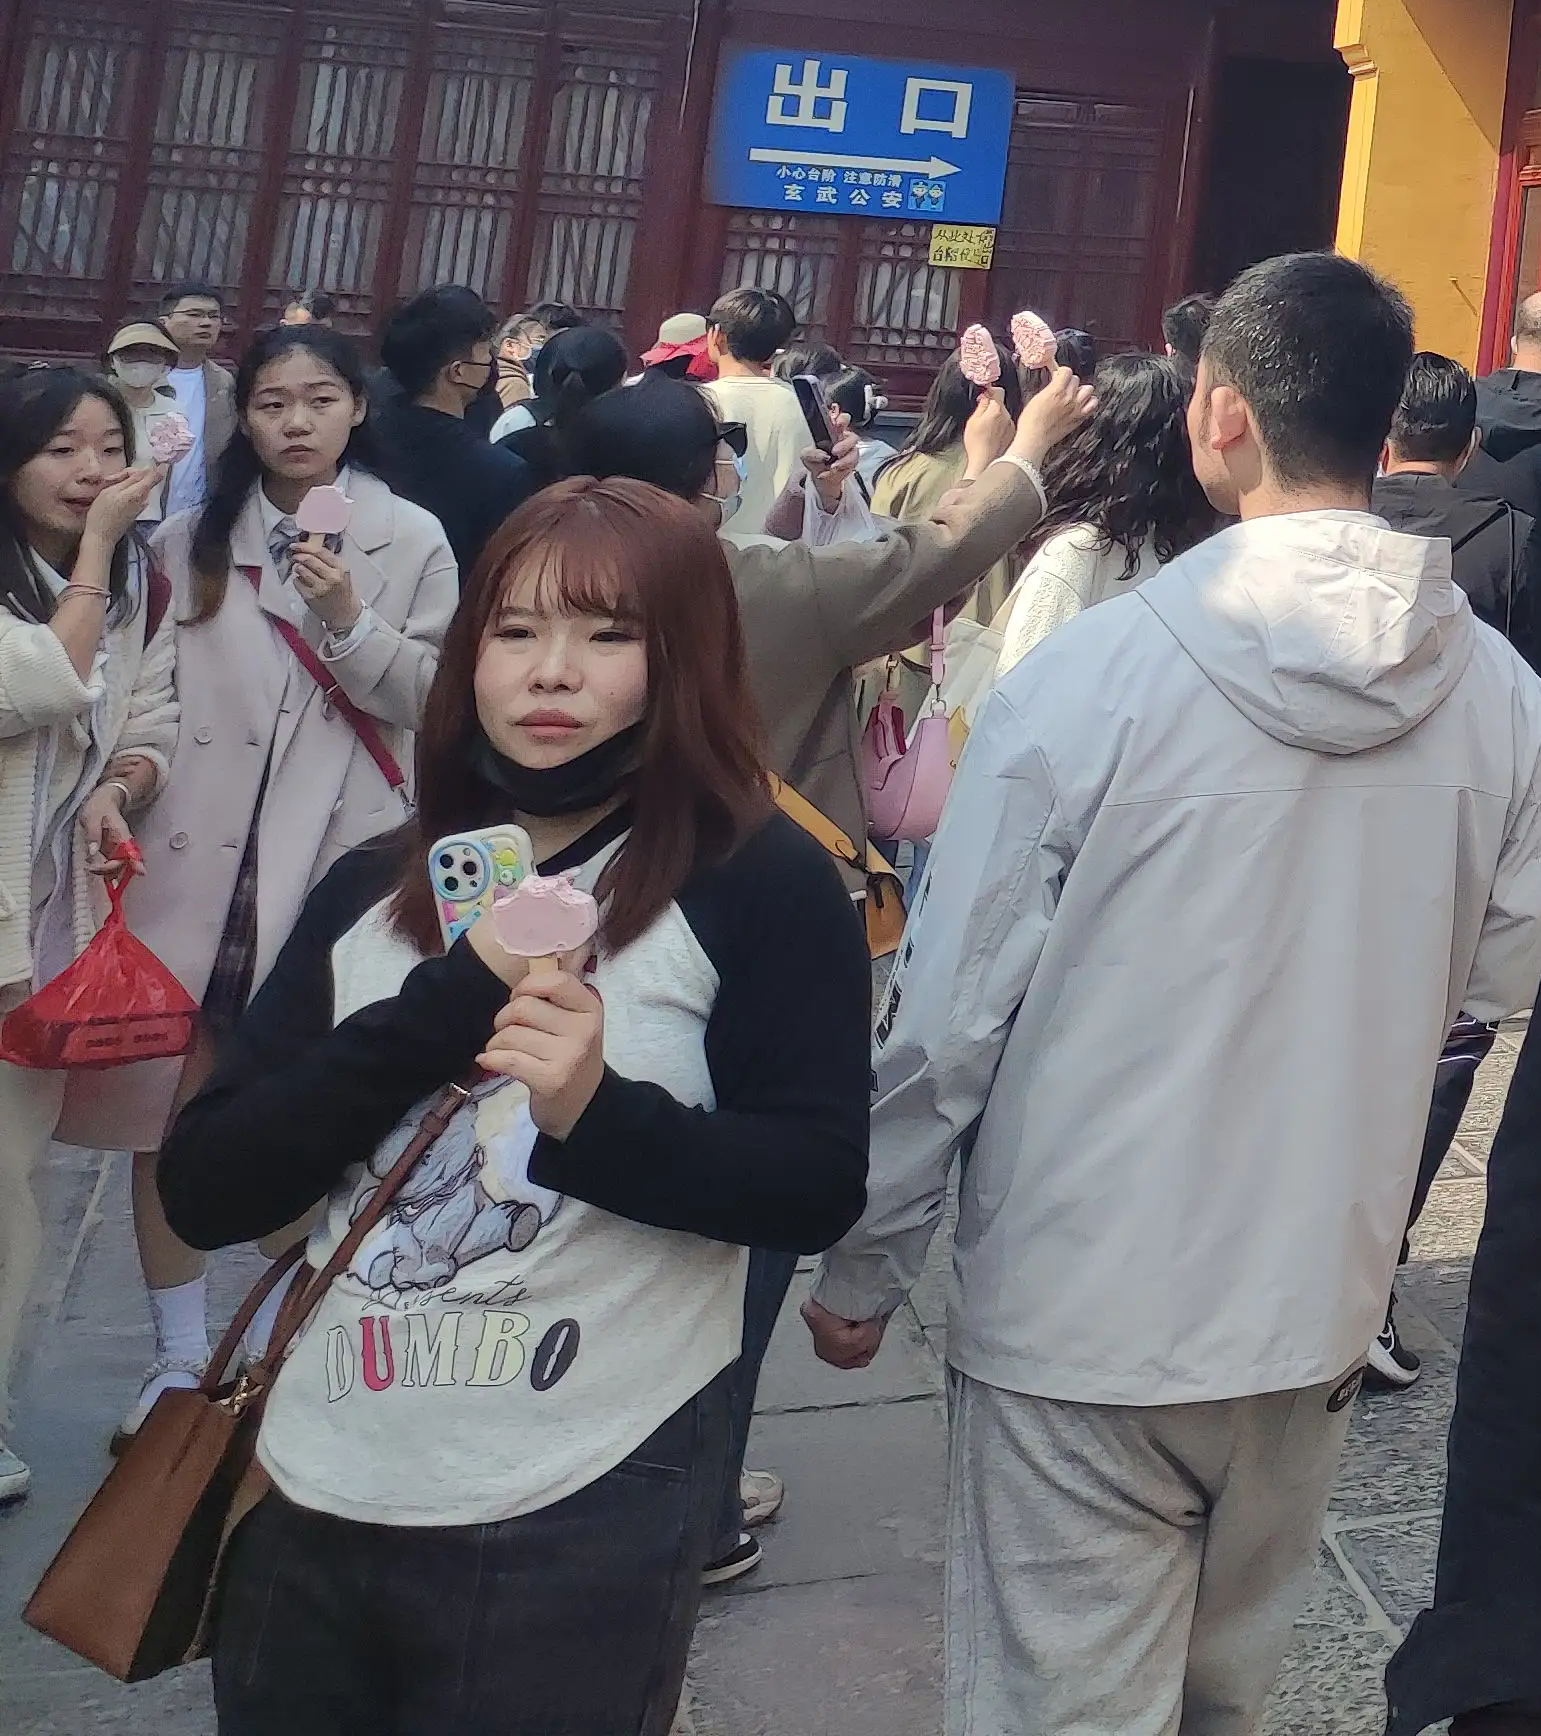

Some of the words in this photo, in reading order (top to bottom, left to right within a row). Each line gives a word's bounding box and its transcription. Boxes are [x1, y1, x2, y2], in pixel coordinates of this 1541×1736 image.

[766, 59, 973, 139] 出口
[776, 165, 837, 183] 小心台阶
[784, 183, 903, 208] 玄武公安
[325, 1310, 581, 1403] DUMBO
